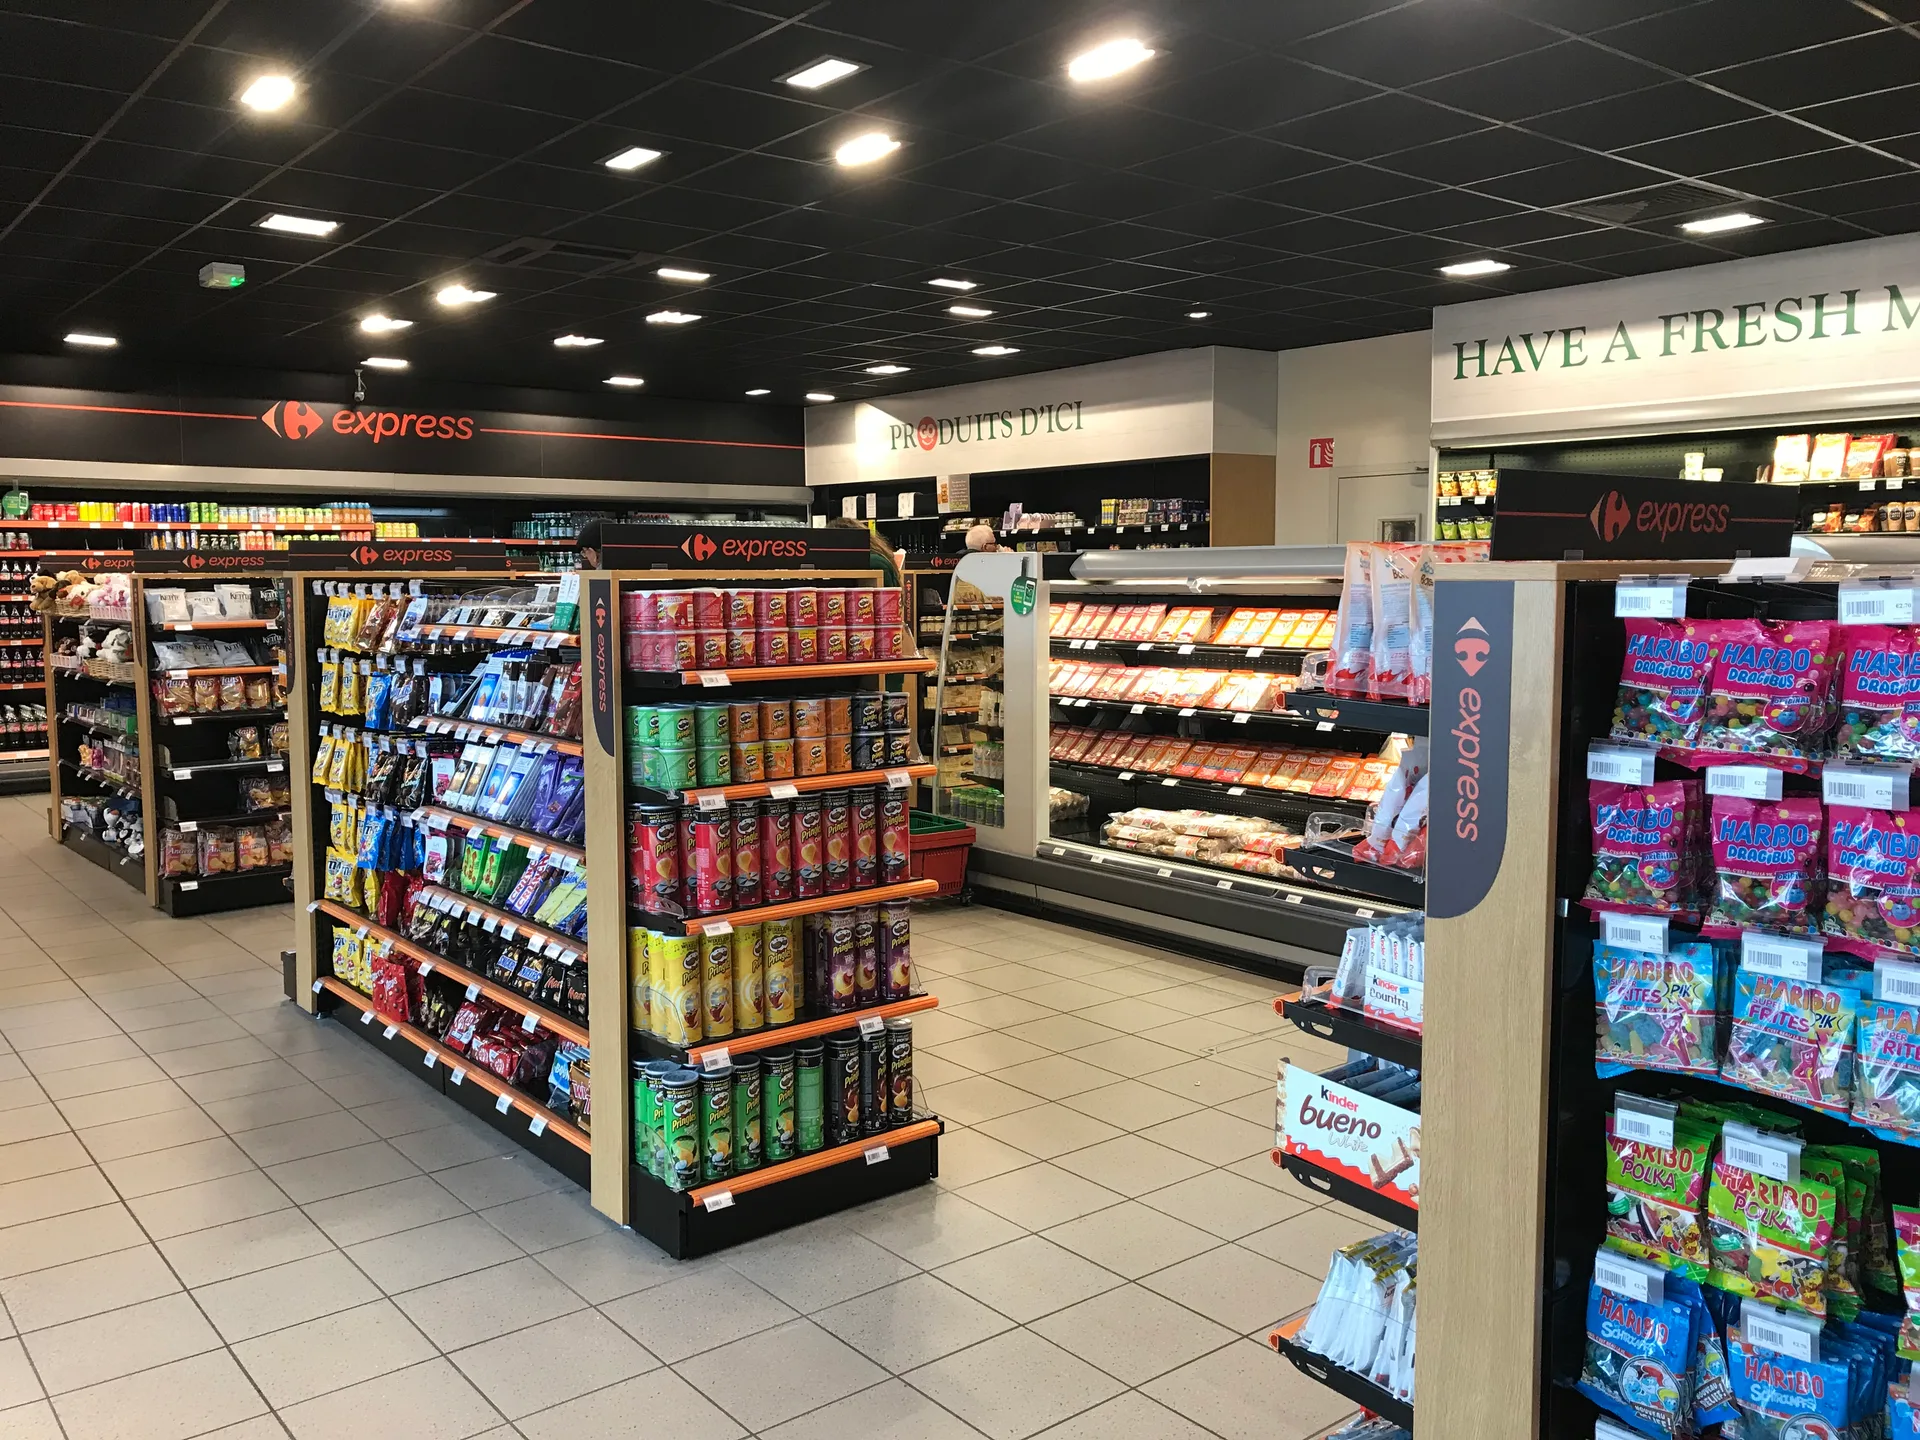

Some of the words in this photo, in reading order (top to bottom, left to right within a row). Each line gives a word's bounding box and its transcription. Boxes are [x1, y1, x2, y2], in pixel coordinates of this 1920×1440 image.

[1453, 326, 1588, 380] HAVE
[1602, 320, 1641, 363] A
[1658, 288, 1862, 357] FRESH
[332, 409, 474, 443] express
[1636, 499, 1729, 543] express
[208, 556, 264, 568] express
[383, 547, 452, 567] express
[722, 537, 807, 562] express
[1627, 634, 1709, 664] HARIBO
[596, 633, 606, 712] express
[1451, 687, 1481, 842] express
[1832, 821, 1920, 859] HARIBO
[1373, 975, 1399, 992] kinder
[1611, 957, 1694, 982] HARIBO
[1369, 988, 1409, 1011] Country
[1754, 976, 1841, 1014] HARIBO
[1749, 1004, 1810, 1033] FRITES
[1320, 1085, 1359, 1112] kinder
[671, 1113, 697, 1132] Pringles
[1300, 1094, 1381, 1139] bueno
[1328, 1130, 1368, 1152] White
[1621, 1159, 1676, 1192] POLKA
[1772, 1161, 1786, 1169] €2.70
[1720, 1165, 1819, 1218] HARIBO
[1733, 1193, 1797, 1235] POLKA
[1599, 1296, 1669, 1344] HARIBO
[1745, 1358, 1824, 1398] HARIBO
